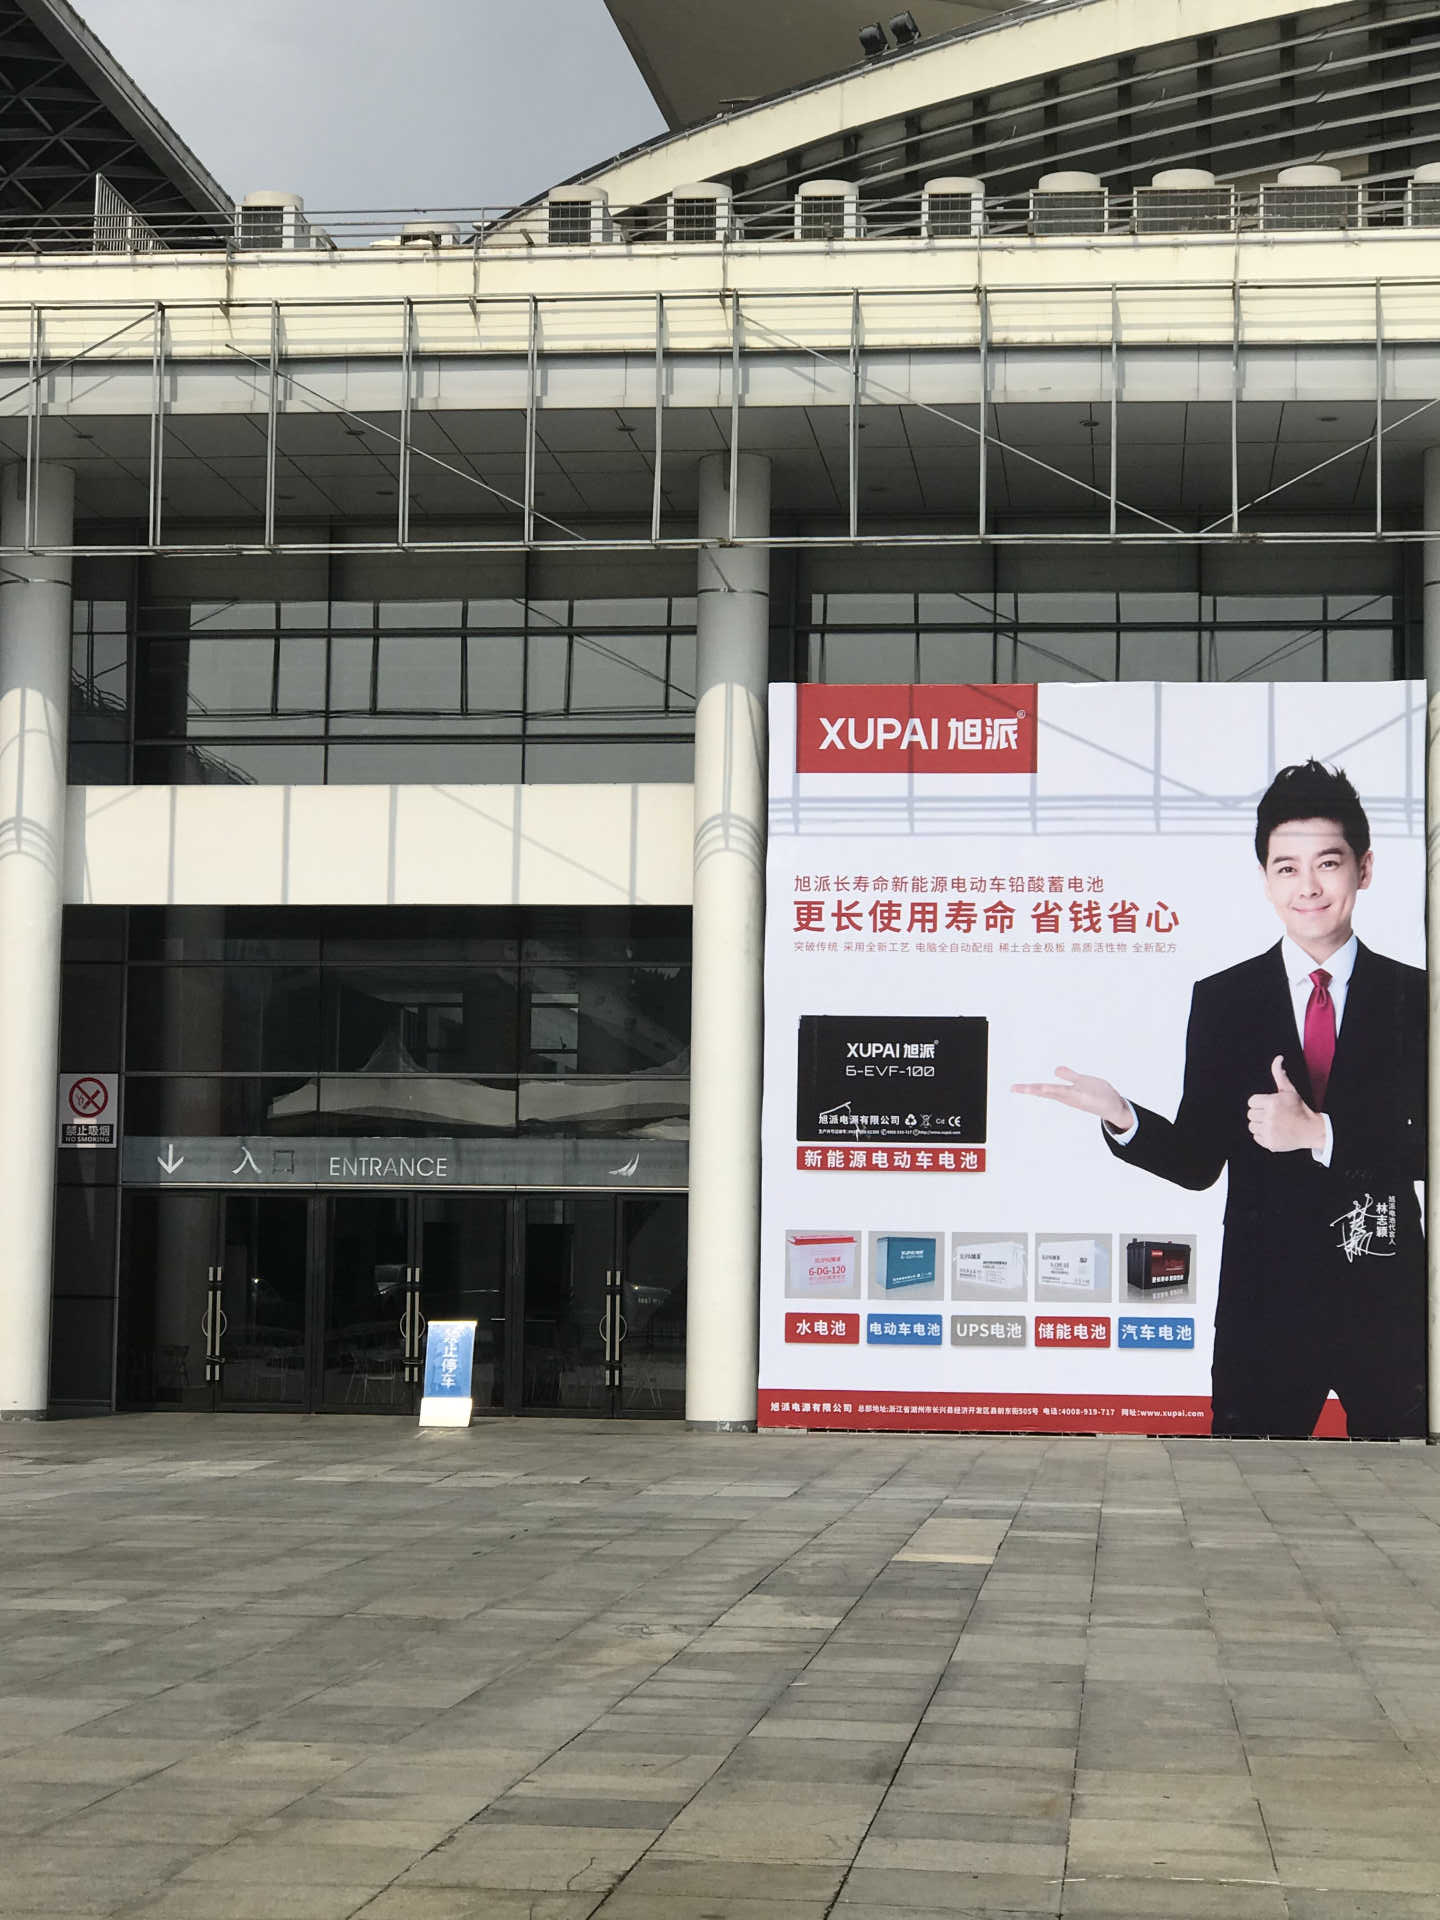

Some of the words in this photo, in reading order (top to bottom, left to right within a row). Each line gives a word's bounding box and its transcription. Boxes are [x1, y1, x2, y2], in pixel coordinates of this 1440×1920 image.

[819, 718, 939, 750] XUPAI
[948, 718, 1018, 750] 旭派
[794, 875, 1104, 893] 旭派长寿命新能源电动车铅酸蓄电池
[793, 900, 1016, 933] 更长使用寿命
[1031, 900, 1180, 933] 省钱省心
[794, 942, 838, 952] 突破传统
[843, 942, 910, 953] 采用全新工艺
[915, 943, 993, 953] 电脑全自动配组
[1132, 943, 1177, 953] 全新配方
[847, 1043, 900, 1058] XUPAI
[904, 1043, 935, 1059] 旭派
[845, 1065, 935, 1077] 6-EVF-100
[818, 1115, 900, 1125] 旭派电源有限公司
[65, 1125, 110, 1136] 禁止吸烟
[329, 1157, 448, 1177] ENTRANCE
[804, 1150, 978, 1169] 新能源电动车电池
[808, 1265, 846, 1276] 6-DG-120
[796, 1320, 846, 1336] 水电池
[870, 1323, 941, 1337] 电动车电池
[956, 1323, 1022, 1339] UPS电池
[1038, 1323, 1107, 1340] 储能电池
[1121, 1324, 1193, 1341] 汽车电池
[770, 1402, 853, 1412] 旭派电源有限公司
